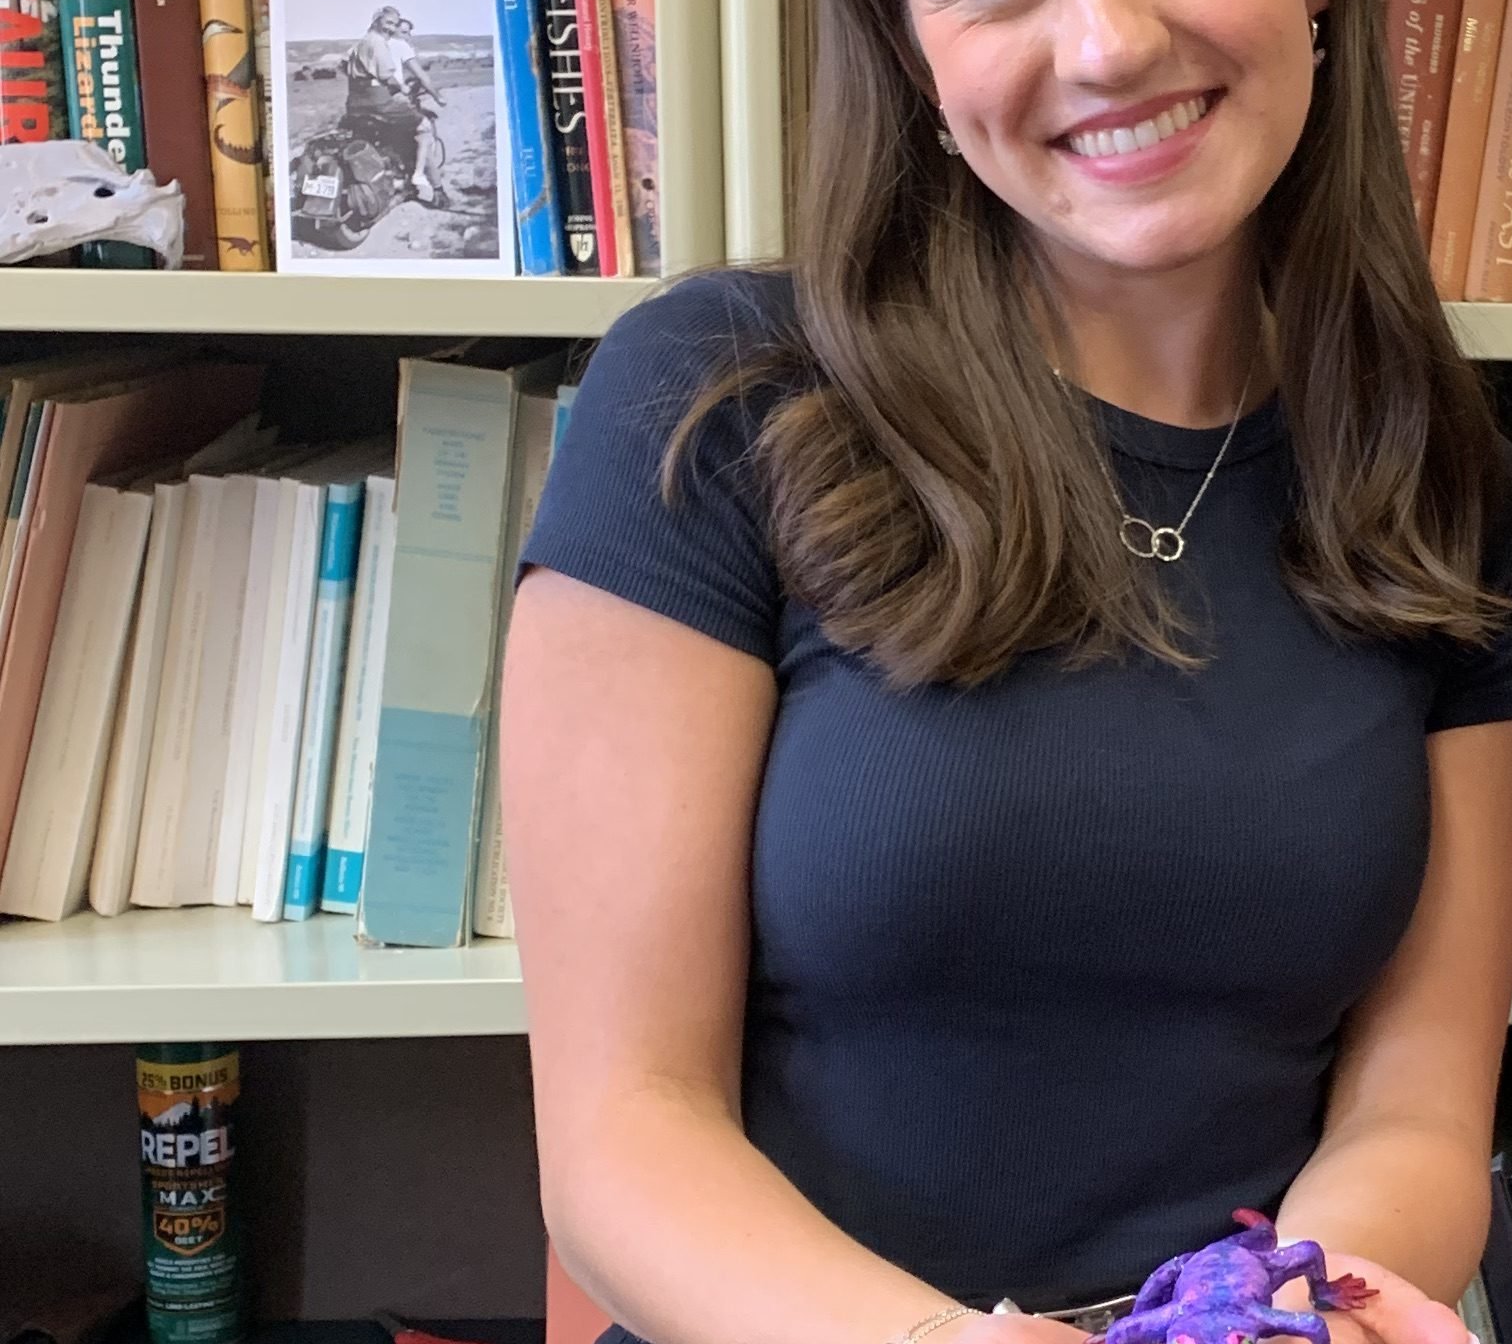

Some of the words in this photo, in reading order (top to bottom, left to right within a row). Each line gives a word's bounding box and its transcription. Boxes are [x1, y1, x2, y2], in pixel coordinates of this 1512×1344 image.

[1405, 10, 1424, 35] of
[1462, 17, 1479, 52] Miles
[1403, 36, 1422, 67] the
[169, 1067, 229, 1091] BONUS
[140, 1125, 236, 1169] REPEL
[159, 1183, 228, 1207] MAX
[158, 1214, 219, 1237] 40%
